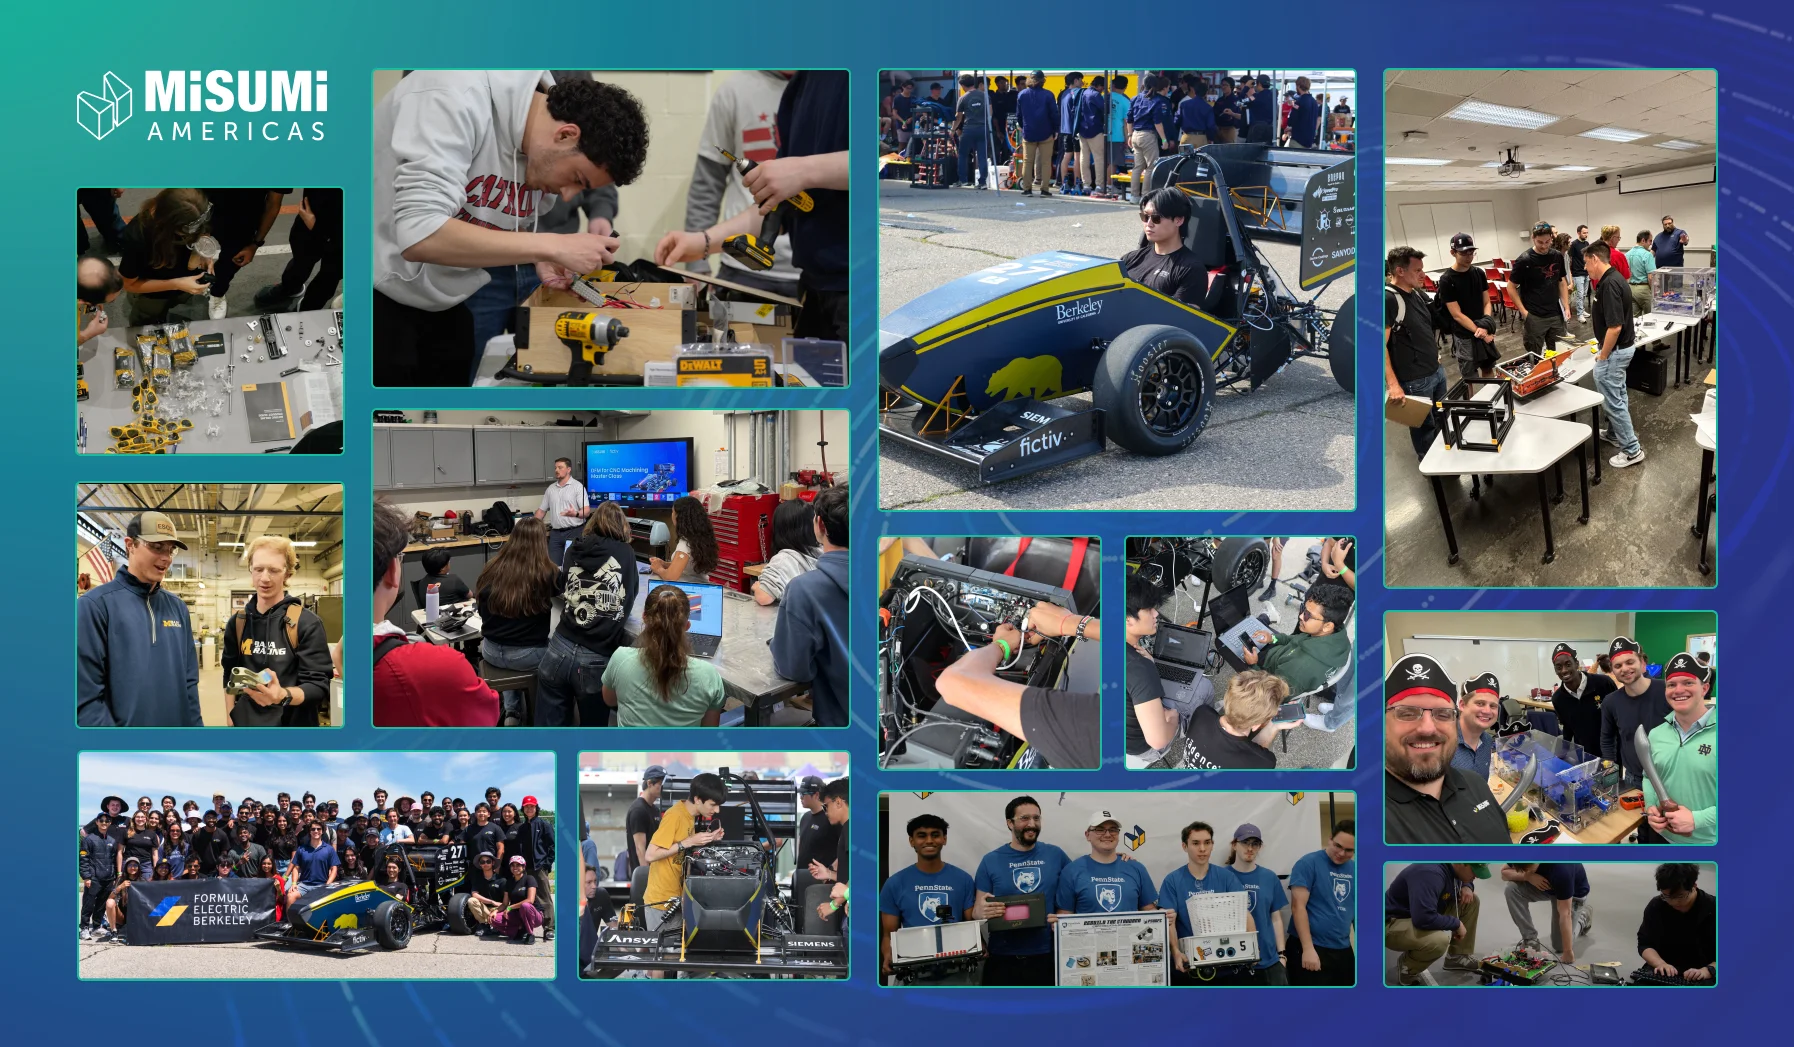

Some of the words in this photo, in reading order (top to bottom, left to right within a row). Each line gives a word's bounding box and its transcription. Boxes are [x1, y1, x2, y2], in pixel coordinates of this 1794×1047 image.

[465, 174, 545, 217] CATHO
[1055, 297, 1103, 321] Berkeley
[753, 358, 766, 370] 5
[1020, 411, 1052, 425] SIEM
[1020, 430, 1063, 457] fictiv
[621, 466, 649, 474] Machining
[254, 640, 276, 648] BAA
[252, 647, 287, 656] RAING
[194, 893, 249, 903] FORMULA
[193, 904, 249, 914] ELECTRIC
[193, 915, 254, 925] BERKELEY
[607, 934, 659, 945] Ansys
[1239, 940, 1247, 951] 5
